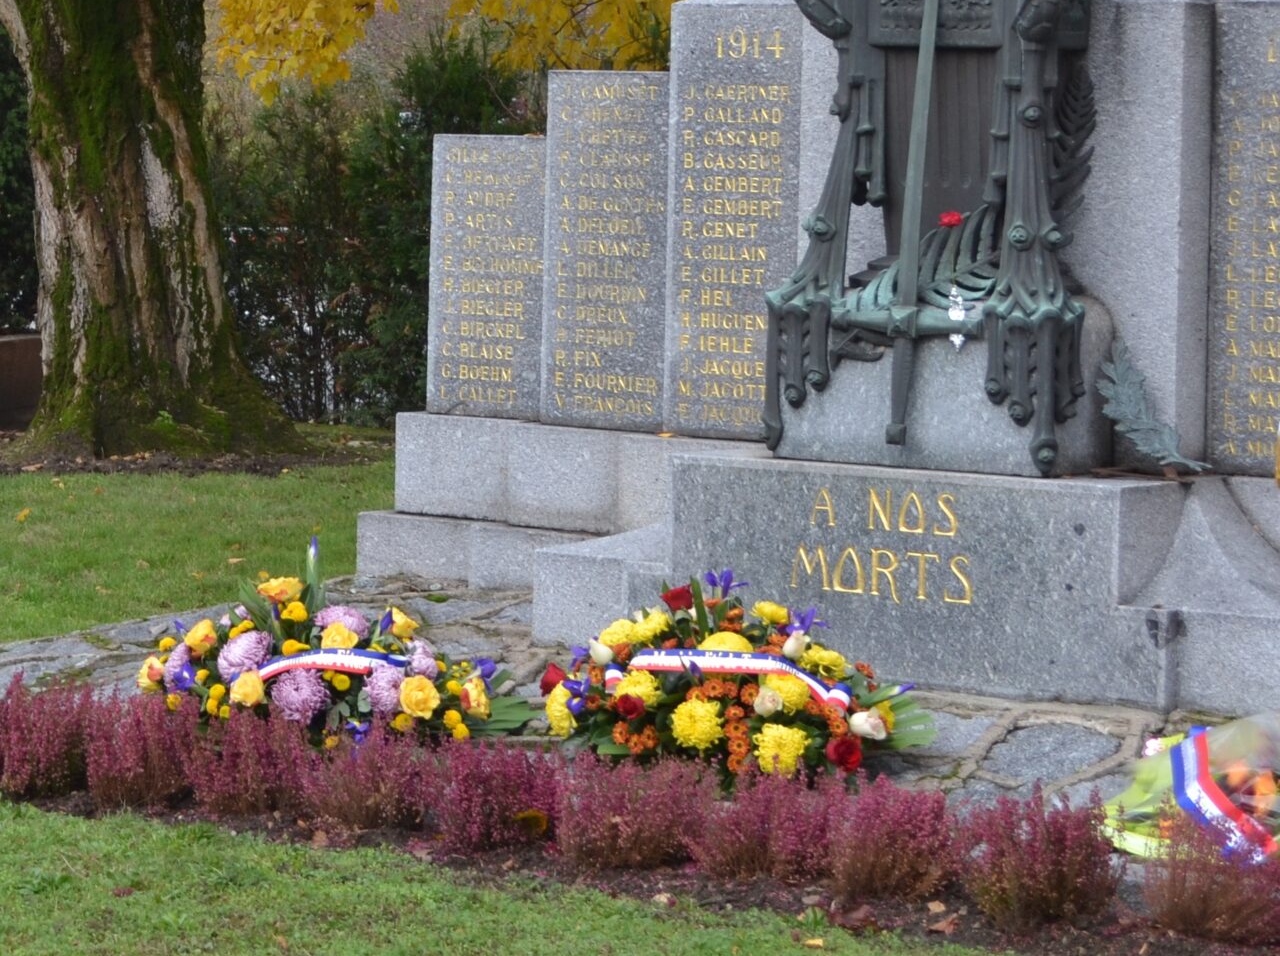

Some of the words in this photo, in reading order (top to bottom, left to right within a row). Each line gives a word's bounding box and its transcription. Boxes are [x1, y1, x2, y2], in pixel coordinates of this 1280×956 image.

[715, 28, 785, 59] 1914
[684, 107, 701, 123] P.
[704, 107, 784, 124] GALLAND
[704, 131, 781, 148] GASCARD
[683, 153, 701, 169] B.
[684, 175, 700, 192] A.
[703, 176, 783, 195] GEMBERT
[702, 199, 784, 219] GEMBERT
[681, 221, 699, 240] R.
[702, 222, 759, 238] GENET
[702, 245, 767, 261] GILLAIN
[682, 266, 697, 282] E.
[701, 267, 765, 285] GILLET
[461, 299, 525, 320] BIEGLER
[680, 312, 697, 328] H.
[700, 312, 768, 330] HUGUEN
[460, 342, 514, 360] BLAISE
[699, 335, 754, 354] IEHLE
[574, 350, 602, 368] FIX
[459, 365, 513, 382] BOEHM
[574, 373, 657, 396] FOURNIER
[810, 487, 836, 527] A
[867, 487, 959, 537] NOS
[789, 542, 974, 605] MORTS
